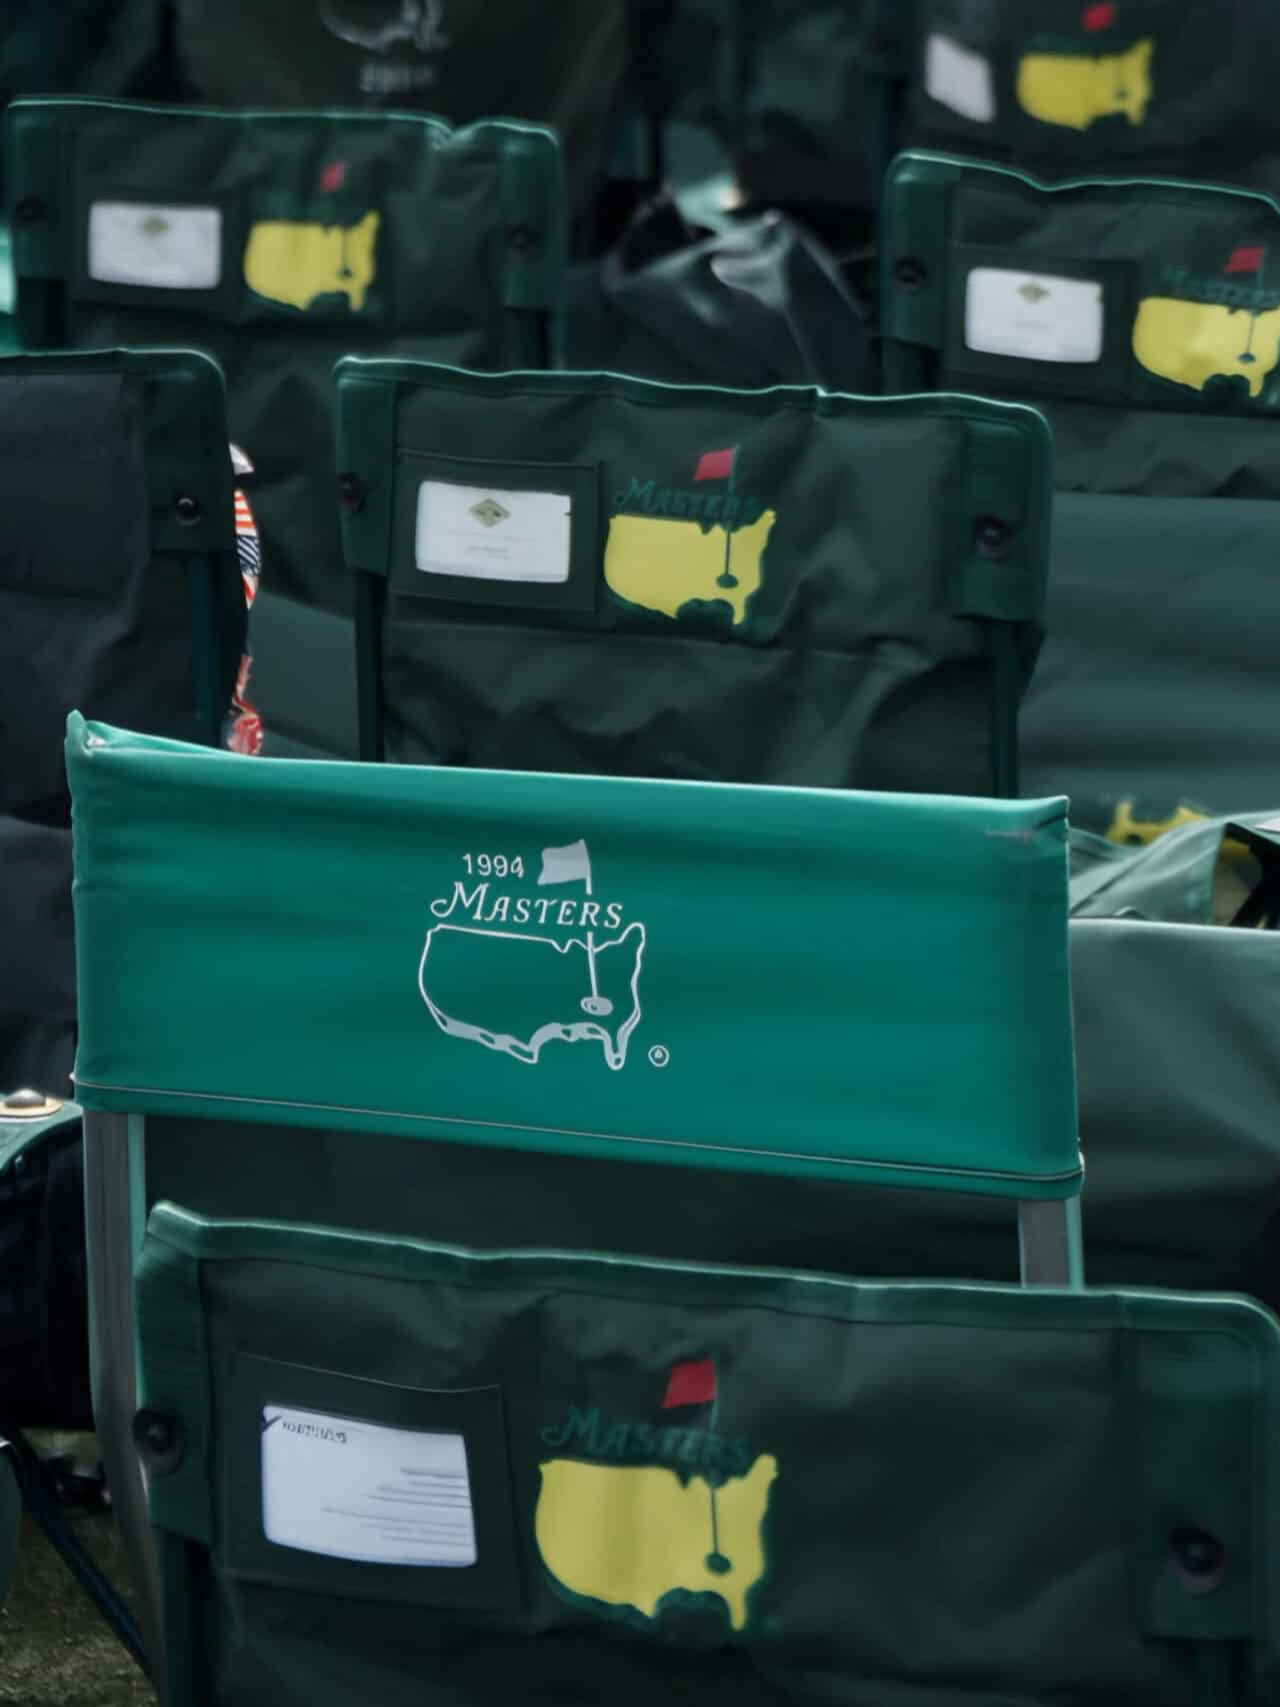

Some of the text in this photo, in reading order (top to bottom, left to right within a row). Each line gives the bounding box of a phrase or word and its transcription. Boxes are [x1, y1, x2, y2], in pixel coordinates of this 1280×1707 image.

[462, 854, 525, 879] 1994
[430, 881, 624, 929] MASTERS
[540, 1405, 750, 1465] MASTERS
